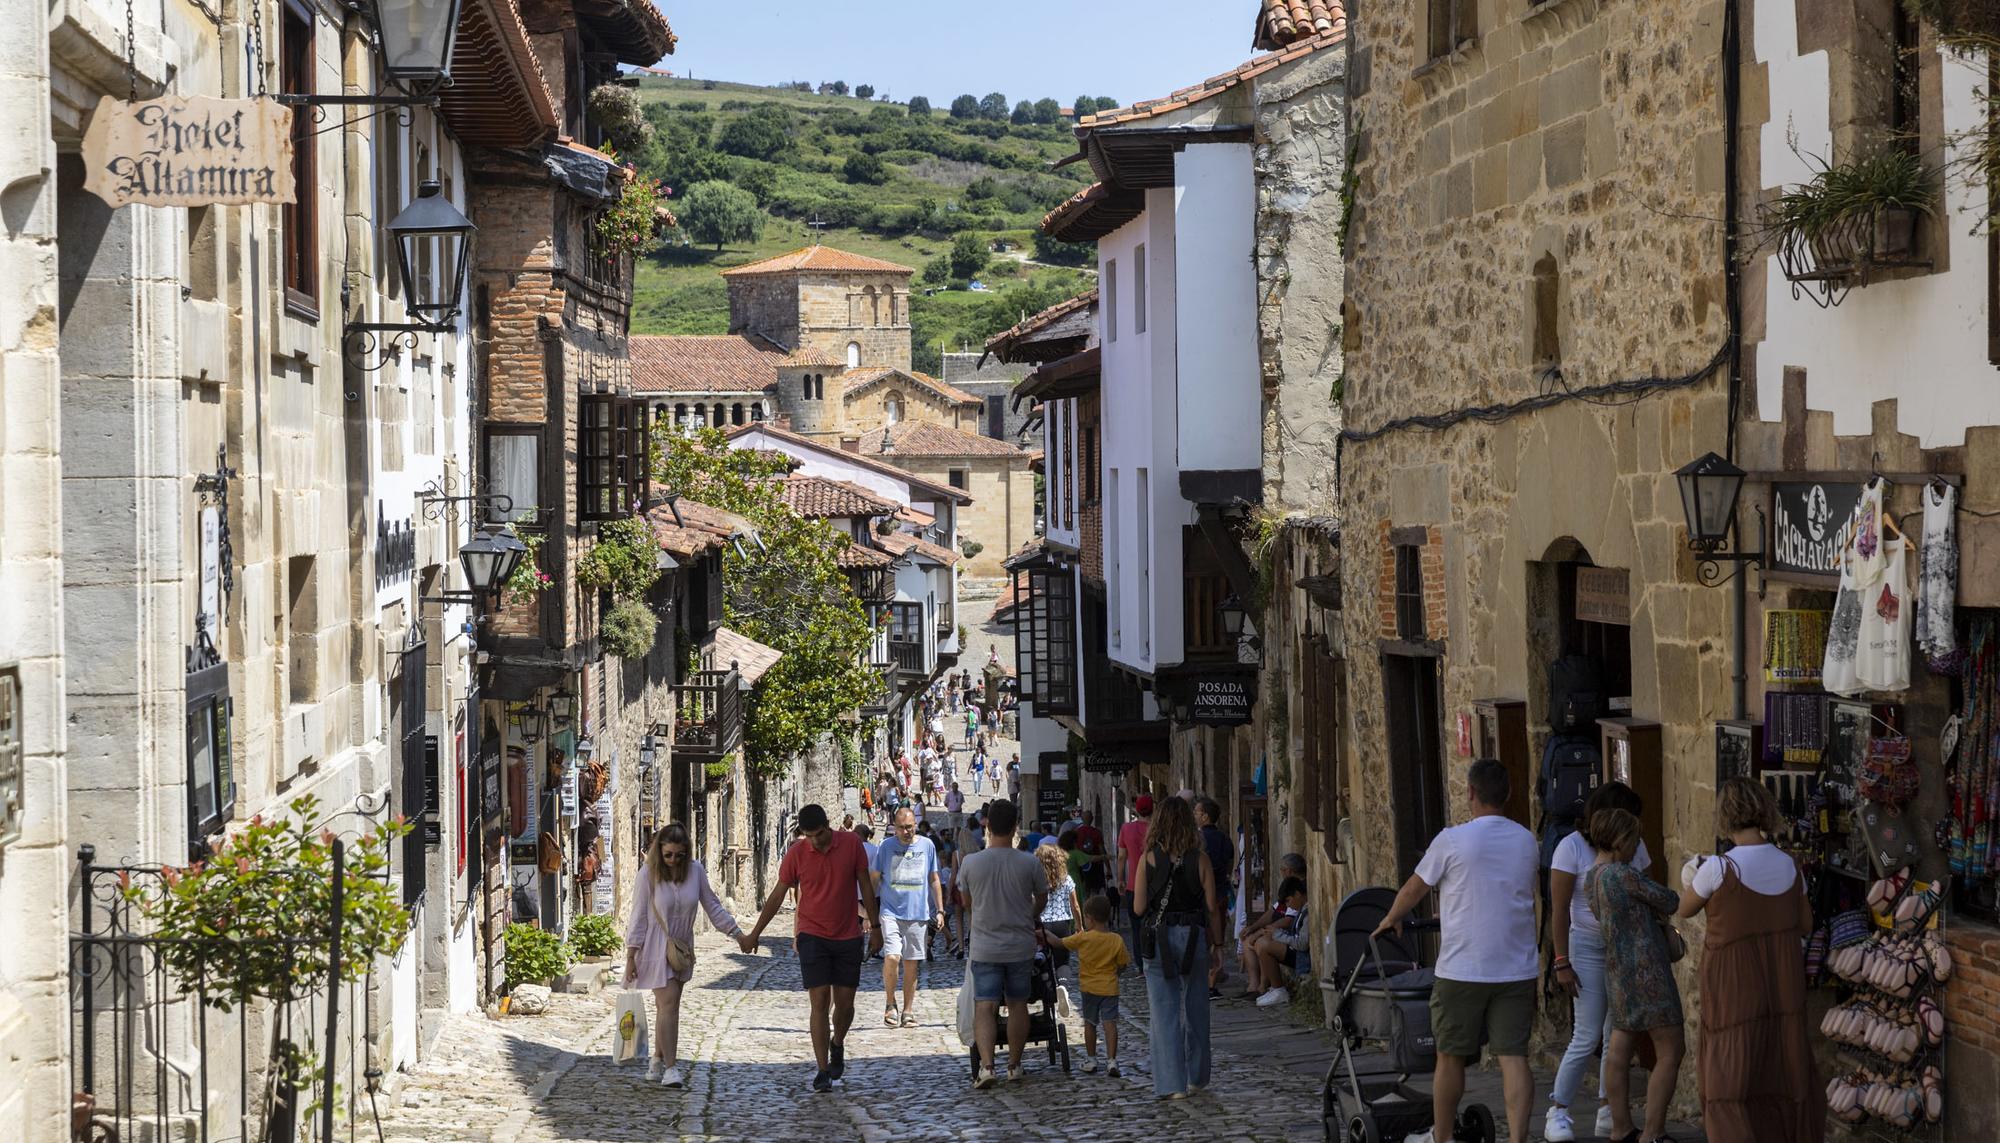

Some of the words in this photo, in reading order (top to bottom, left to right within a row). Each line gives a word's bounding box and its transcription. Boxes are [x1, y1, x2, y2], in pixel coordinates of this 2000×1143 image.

[105, 155, 276, 199] Altamira
[1775, 491, 1860, 571] CACHAVAC
[1774, 668, 1823, 678] TOBILLER
[1198, 682, 1243, 693] POSADA
[1194, 694, 1247, 706] ANSORENA
